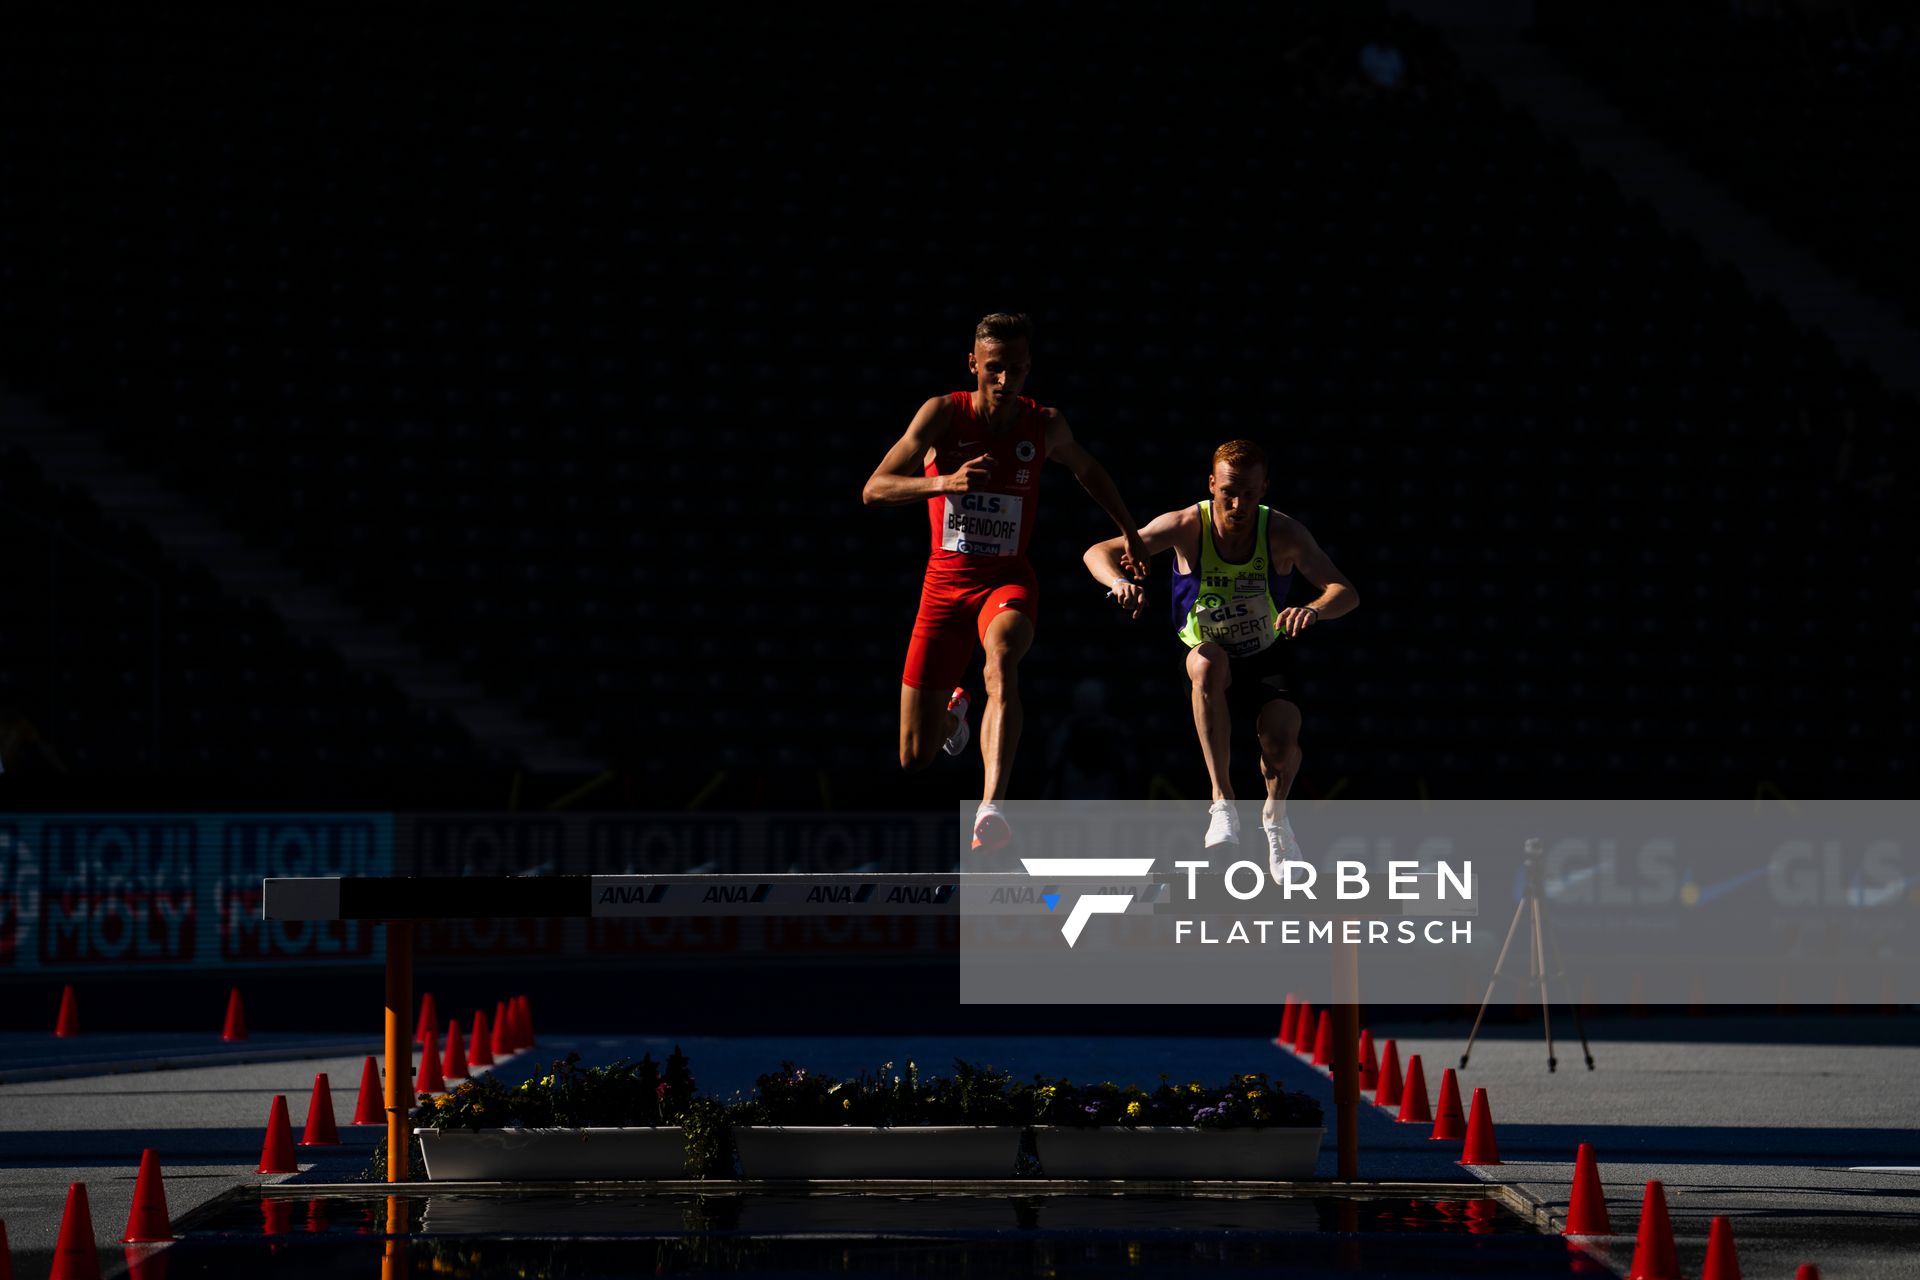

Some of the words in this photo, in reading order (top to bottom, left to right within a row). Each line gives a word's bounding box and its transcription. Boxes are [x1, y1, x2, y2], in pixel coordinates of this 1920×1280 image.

[961, 494, 1001, 513] GLS
[1210, 603, 1249, 623] GLS
[1199, 616, 1268, 640] RUPPERT
[599, 886, 644, 904] ANA
[702, 886, 748, 904] ANA
[805, 886, 851, 904] ANA
[885, 886, 932, 904] ANA
[47, 897, 194, 959] MOLY
